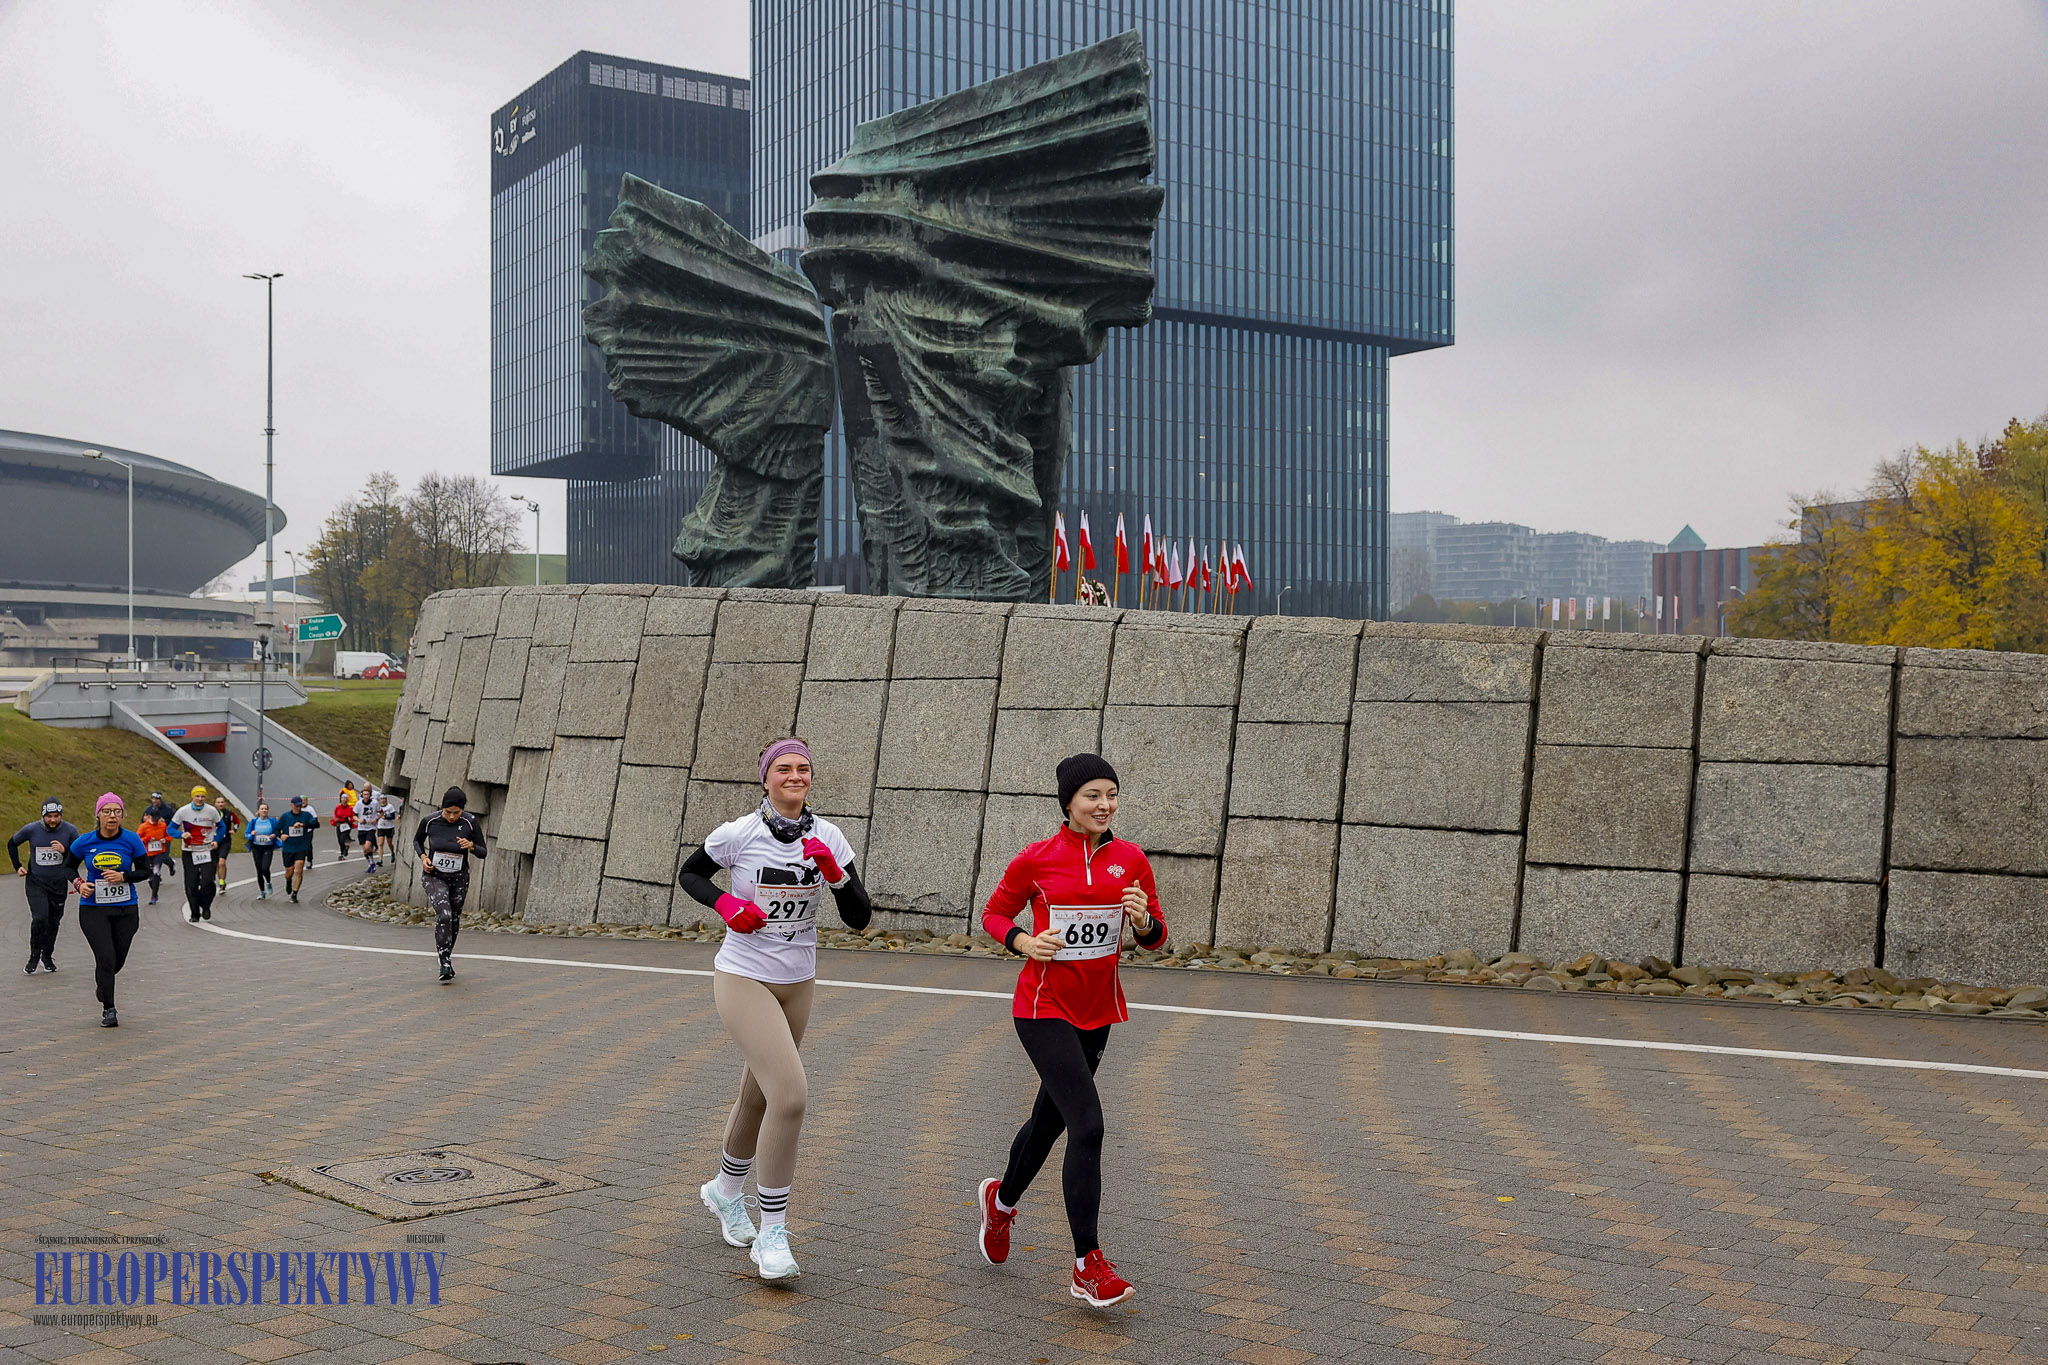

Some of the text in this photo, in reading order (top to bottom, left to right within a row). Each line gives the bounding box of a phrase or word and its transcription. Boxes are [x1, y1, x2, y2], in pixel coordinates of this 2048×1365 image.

[41, 852, 59, 861] 295
[437, 858, 456, 869] 491
[103, 885, 124, 897] 198
[767, 900, 810, 920] 297
[1065, 922, 1109, 945] 689
